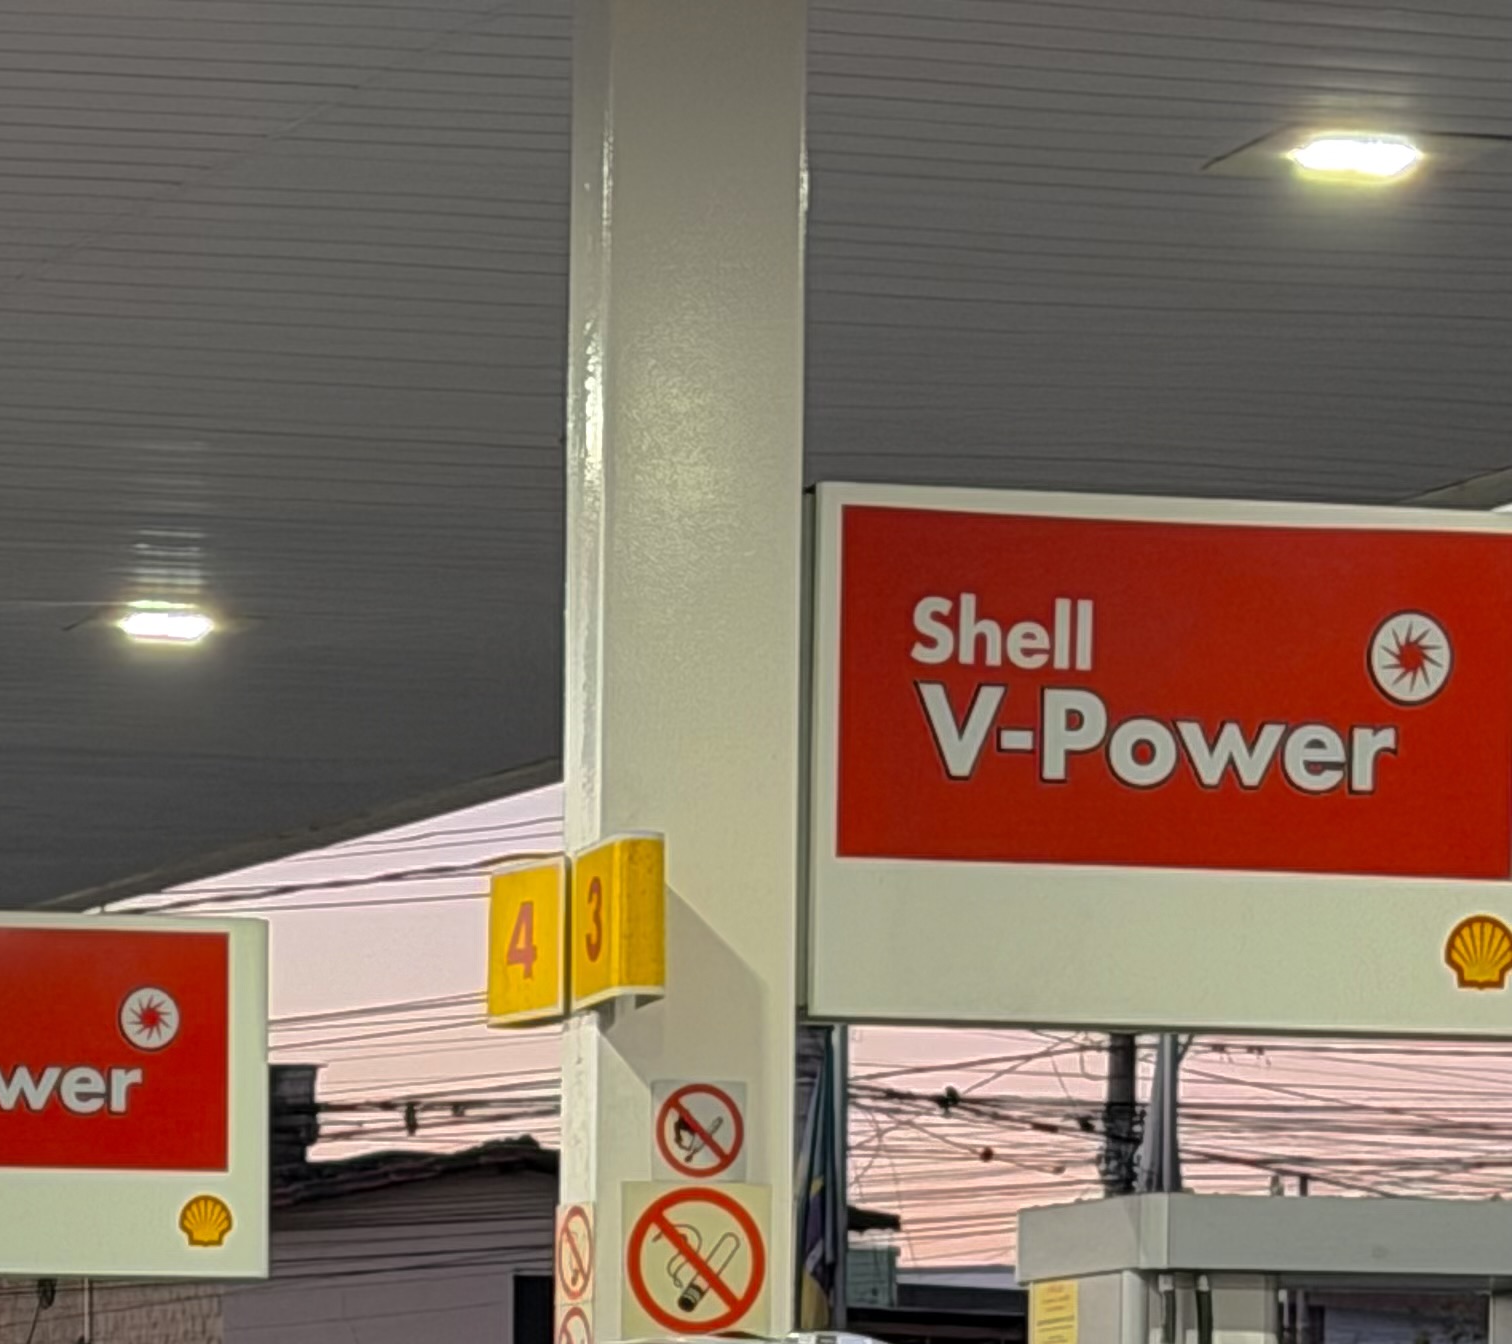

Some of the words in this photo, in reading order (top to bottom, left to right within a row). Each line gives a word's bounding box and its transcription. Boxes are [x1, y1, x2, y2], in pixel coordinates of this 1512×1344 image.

[911, 593, 1094, 671] Shell
[917, 683, 1398, 795] V-Power
[506, 900, 538, 980] 4
[584, 875, 603, 963] 3
